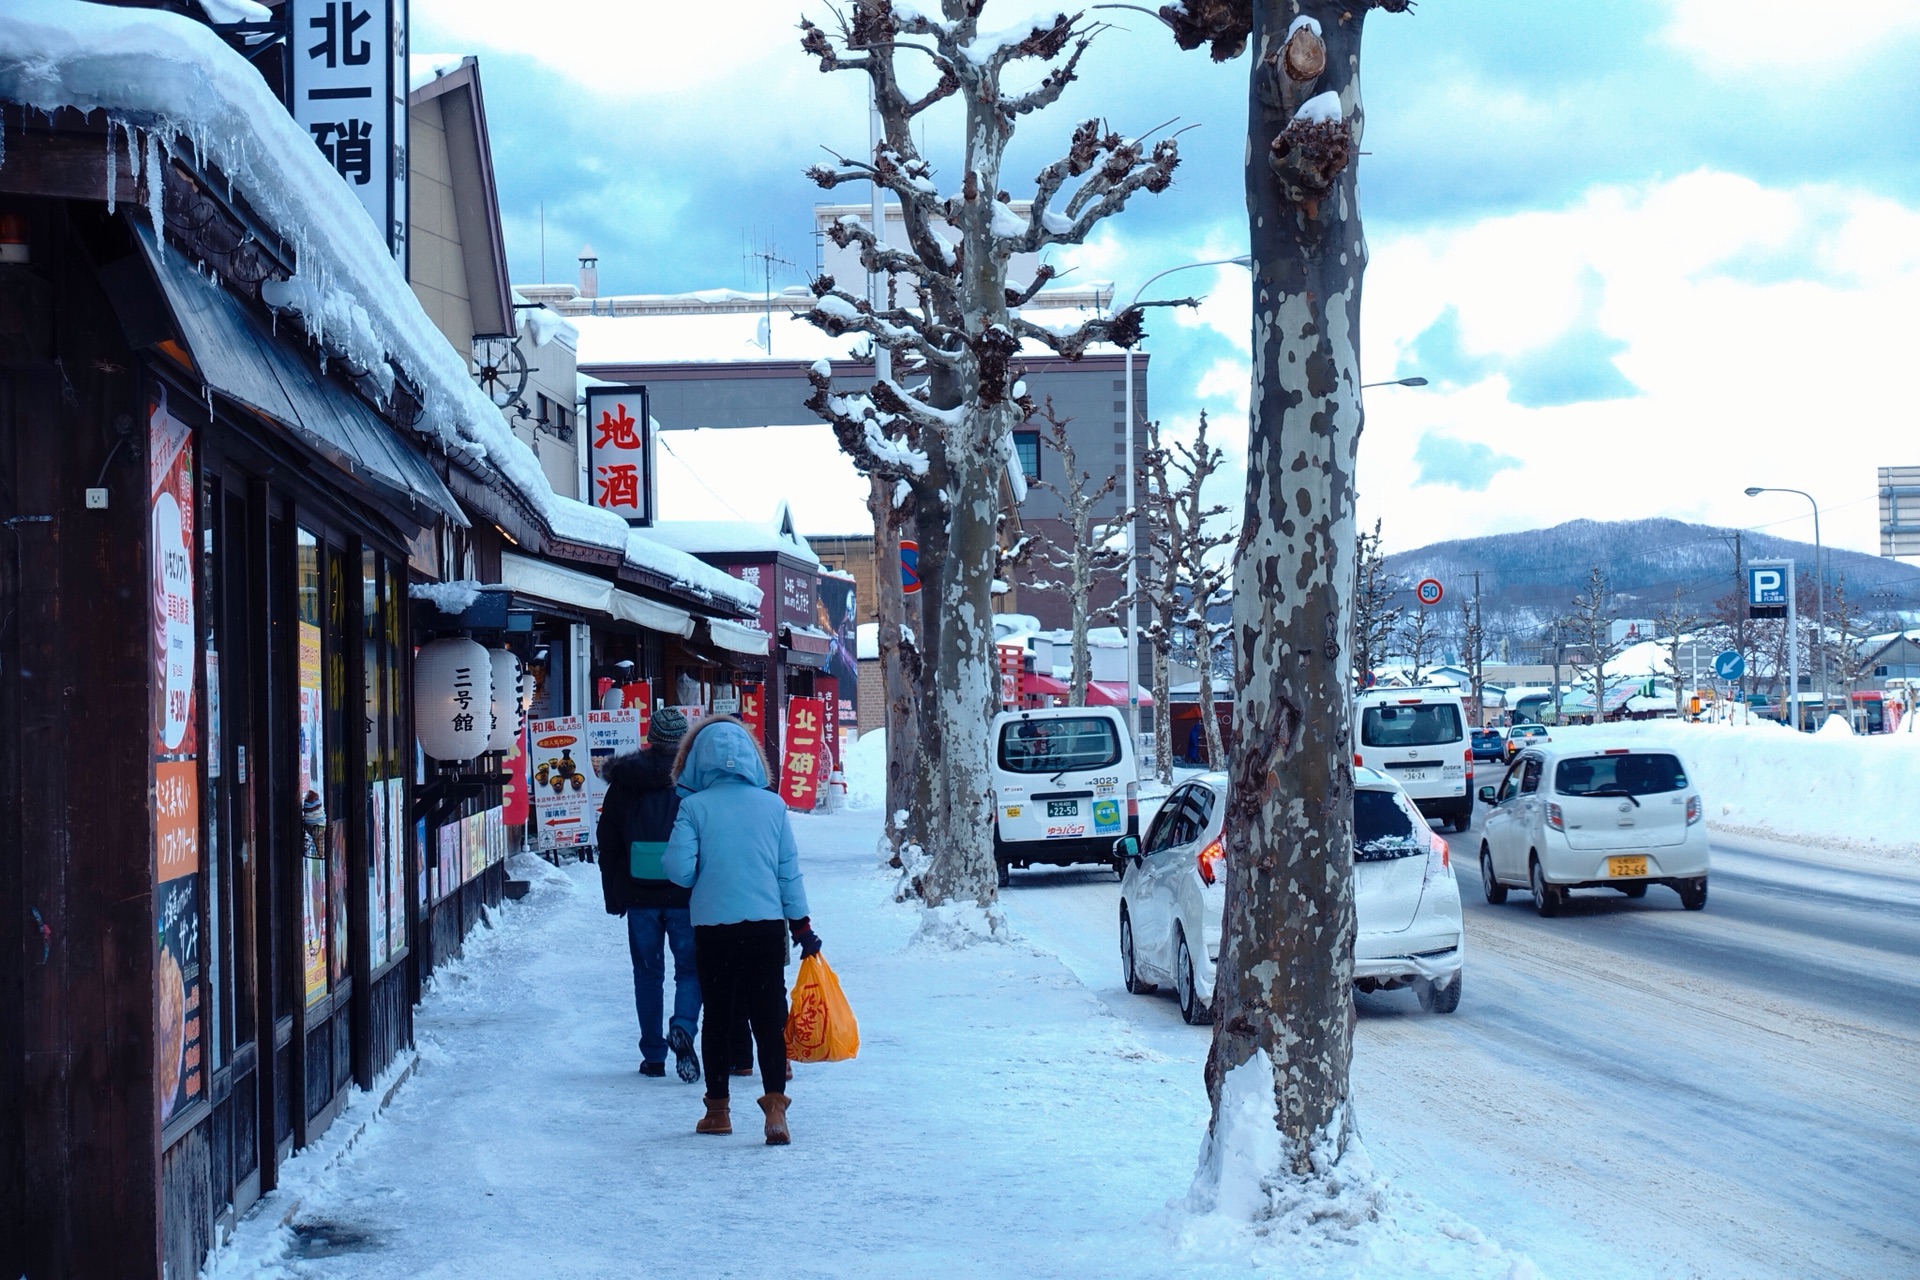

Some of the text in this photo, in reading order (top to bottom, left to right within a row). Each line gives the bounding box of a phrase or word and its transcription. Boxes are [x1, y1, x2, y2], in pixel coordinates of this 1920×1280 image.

[593, 403, 641, 510] 地酒
[1423, 586, 1438, 598] 50
[1755, 571, 1781, 602] P
[452, 668, 474, 732] 三号館
[588, 712, 611, 724] 和風
[825, 691, 834, 743] さしすせそ
[531, 720, 582, 734] 和風 GLASS
[590, 730, 618, 738] 小樽切子
[787, 708, 817, 798] 北一硝子
[1092, 776, 1119, 785] 3023
[1407, 772, 1426, 780] 36-24
[1054, 806, 1077, 816] 22-50
[1047, 825, 1085, 834] ゆうパック
[1617, 865, 1647, 876] 22-66
[178, 911, 199, 967] ザンギ
